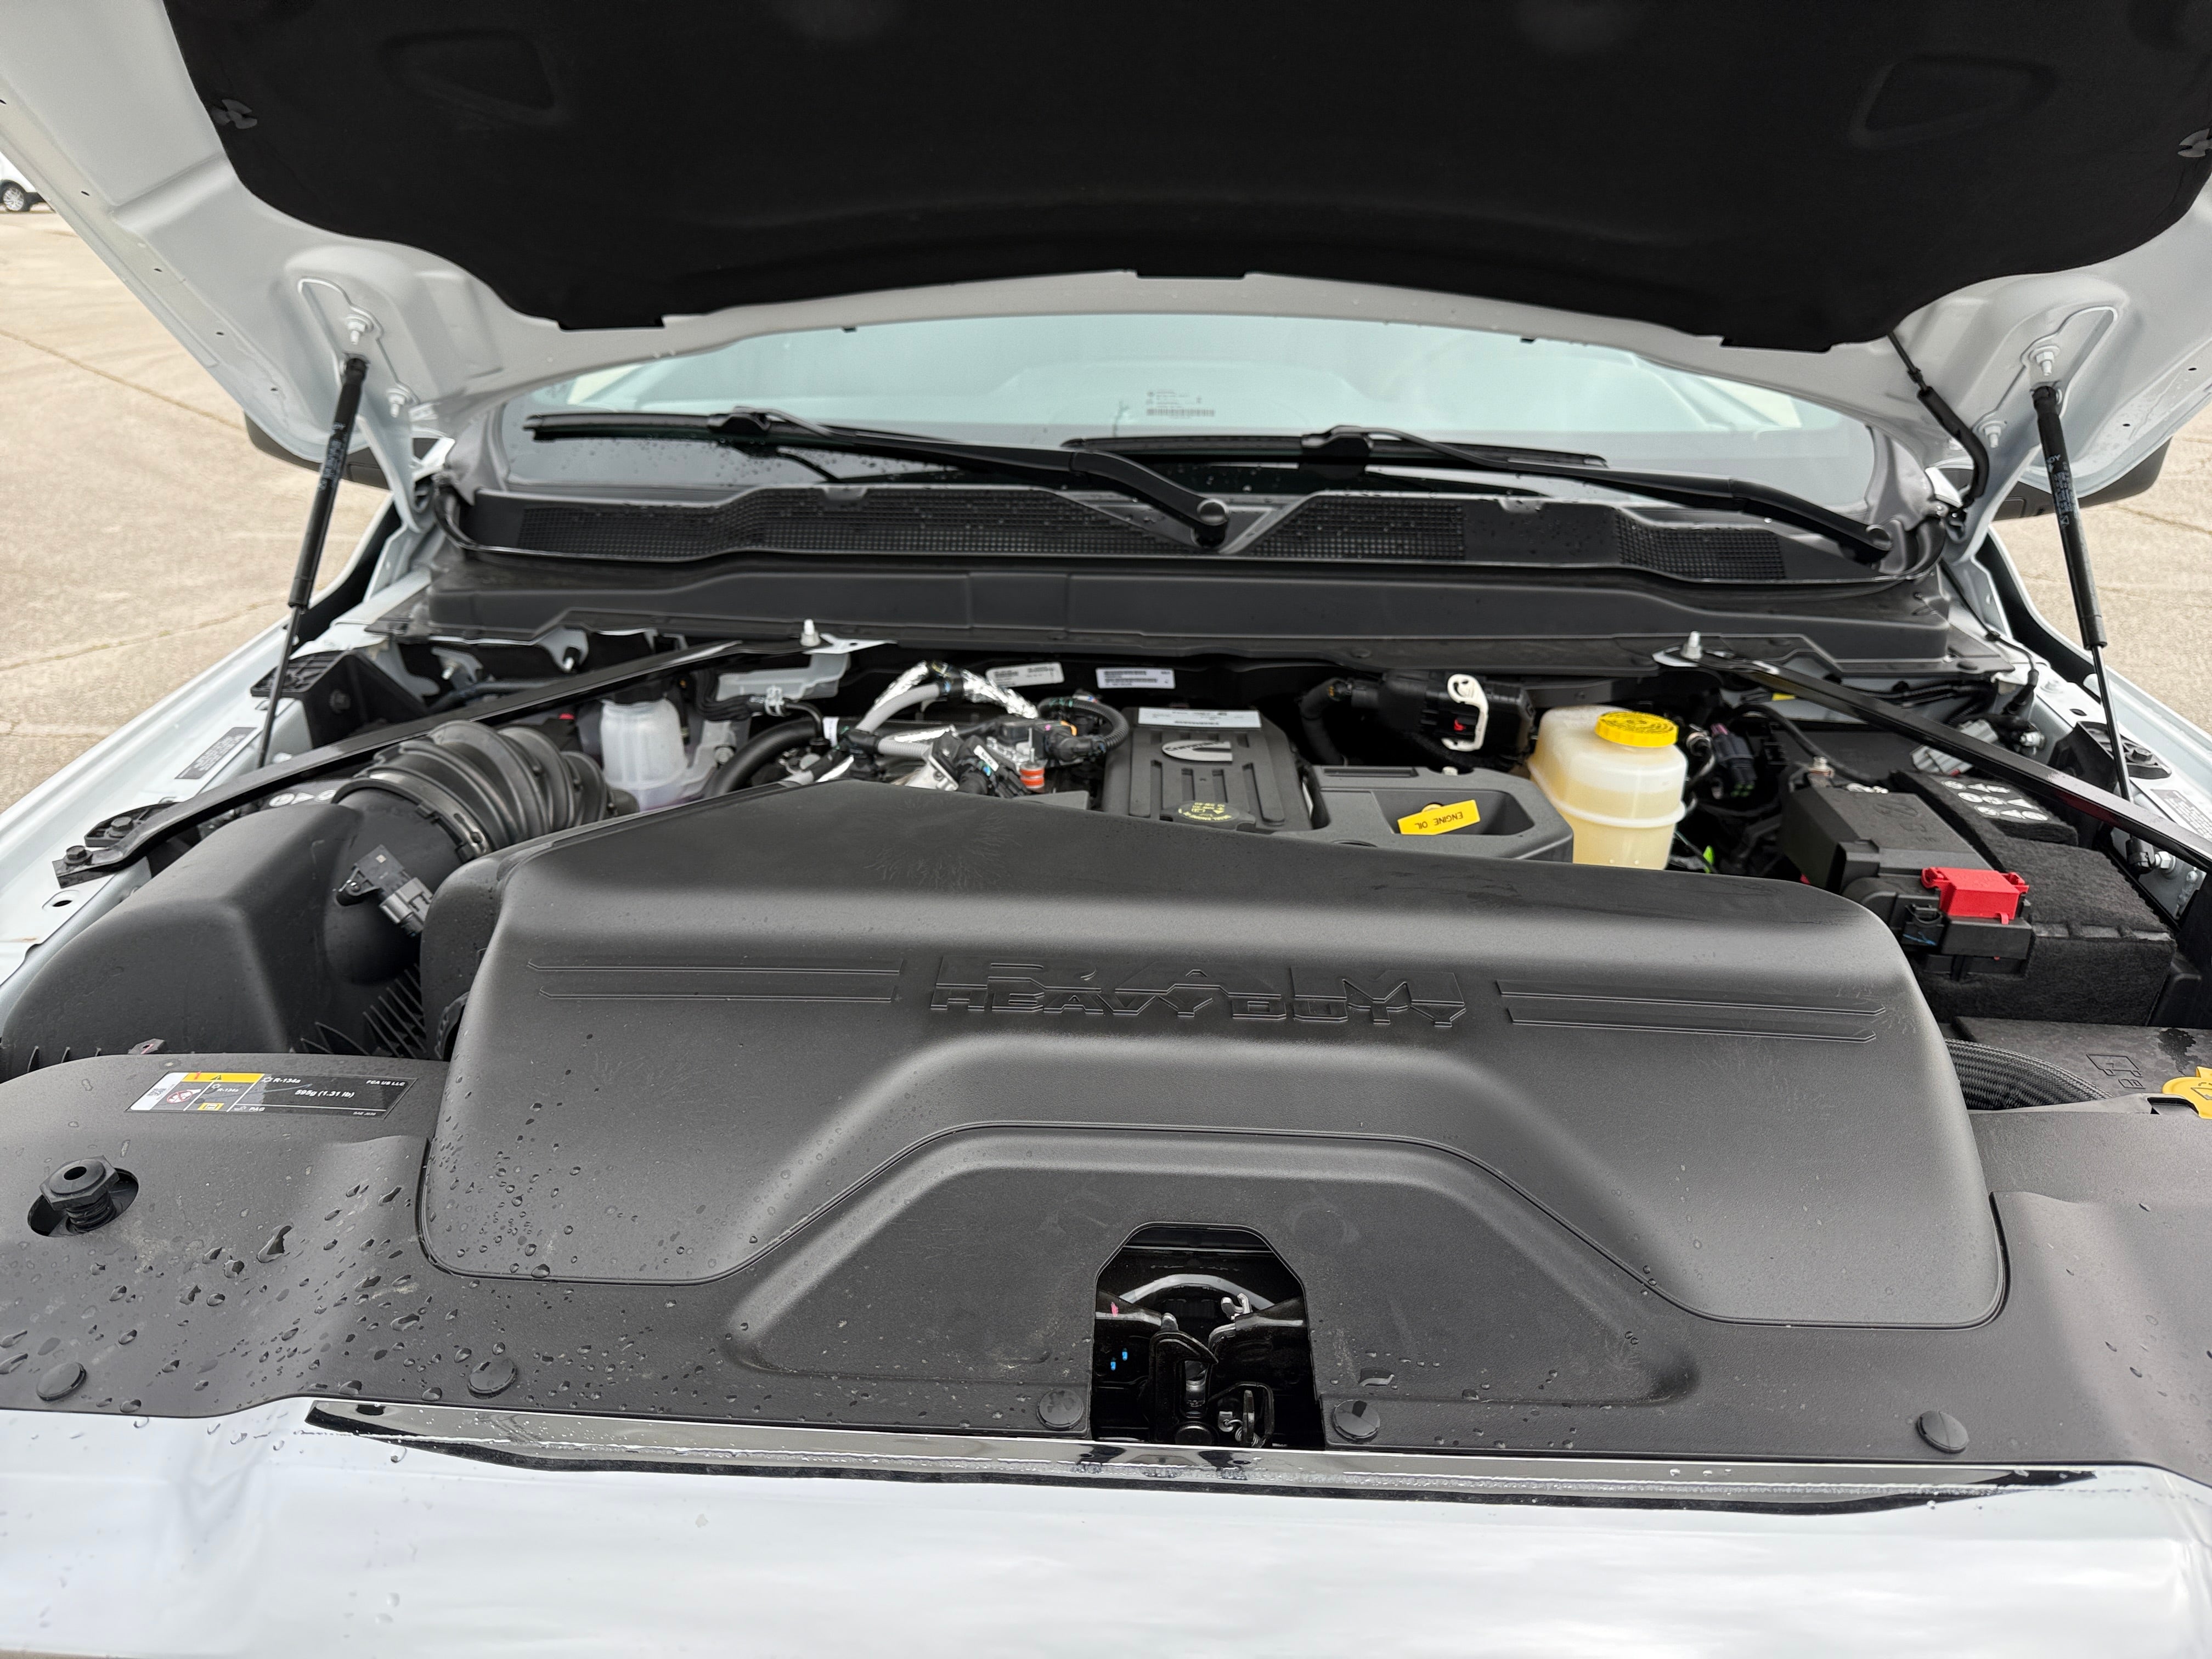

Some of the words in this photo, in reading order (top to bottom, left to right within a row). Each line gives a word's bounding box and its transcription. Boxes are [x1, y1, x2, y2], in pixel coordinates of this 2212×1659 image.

[1414, 821, 1429, 830] OIL
[1433, 811, 1464, 826] ENGINE
[935, 956, 1465, 1006] RAM
[930, 989, 1212, 1018] HEAVY
[1231, 998, 1467, 1028] DUTY
